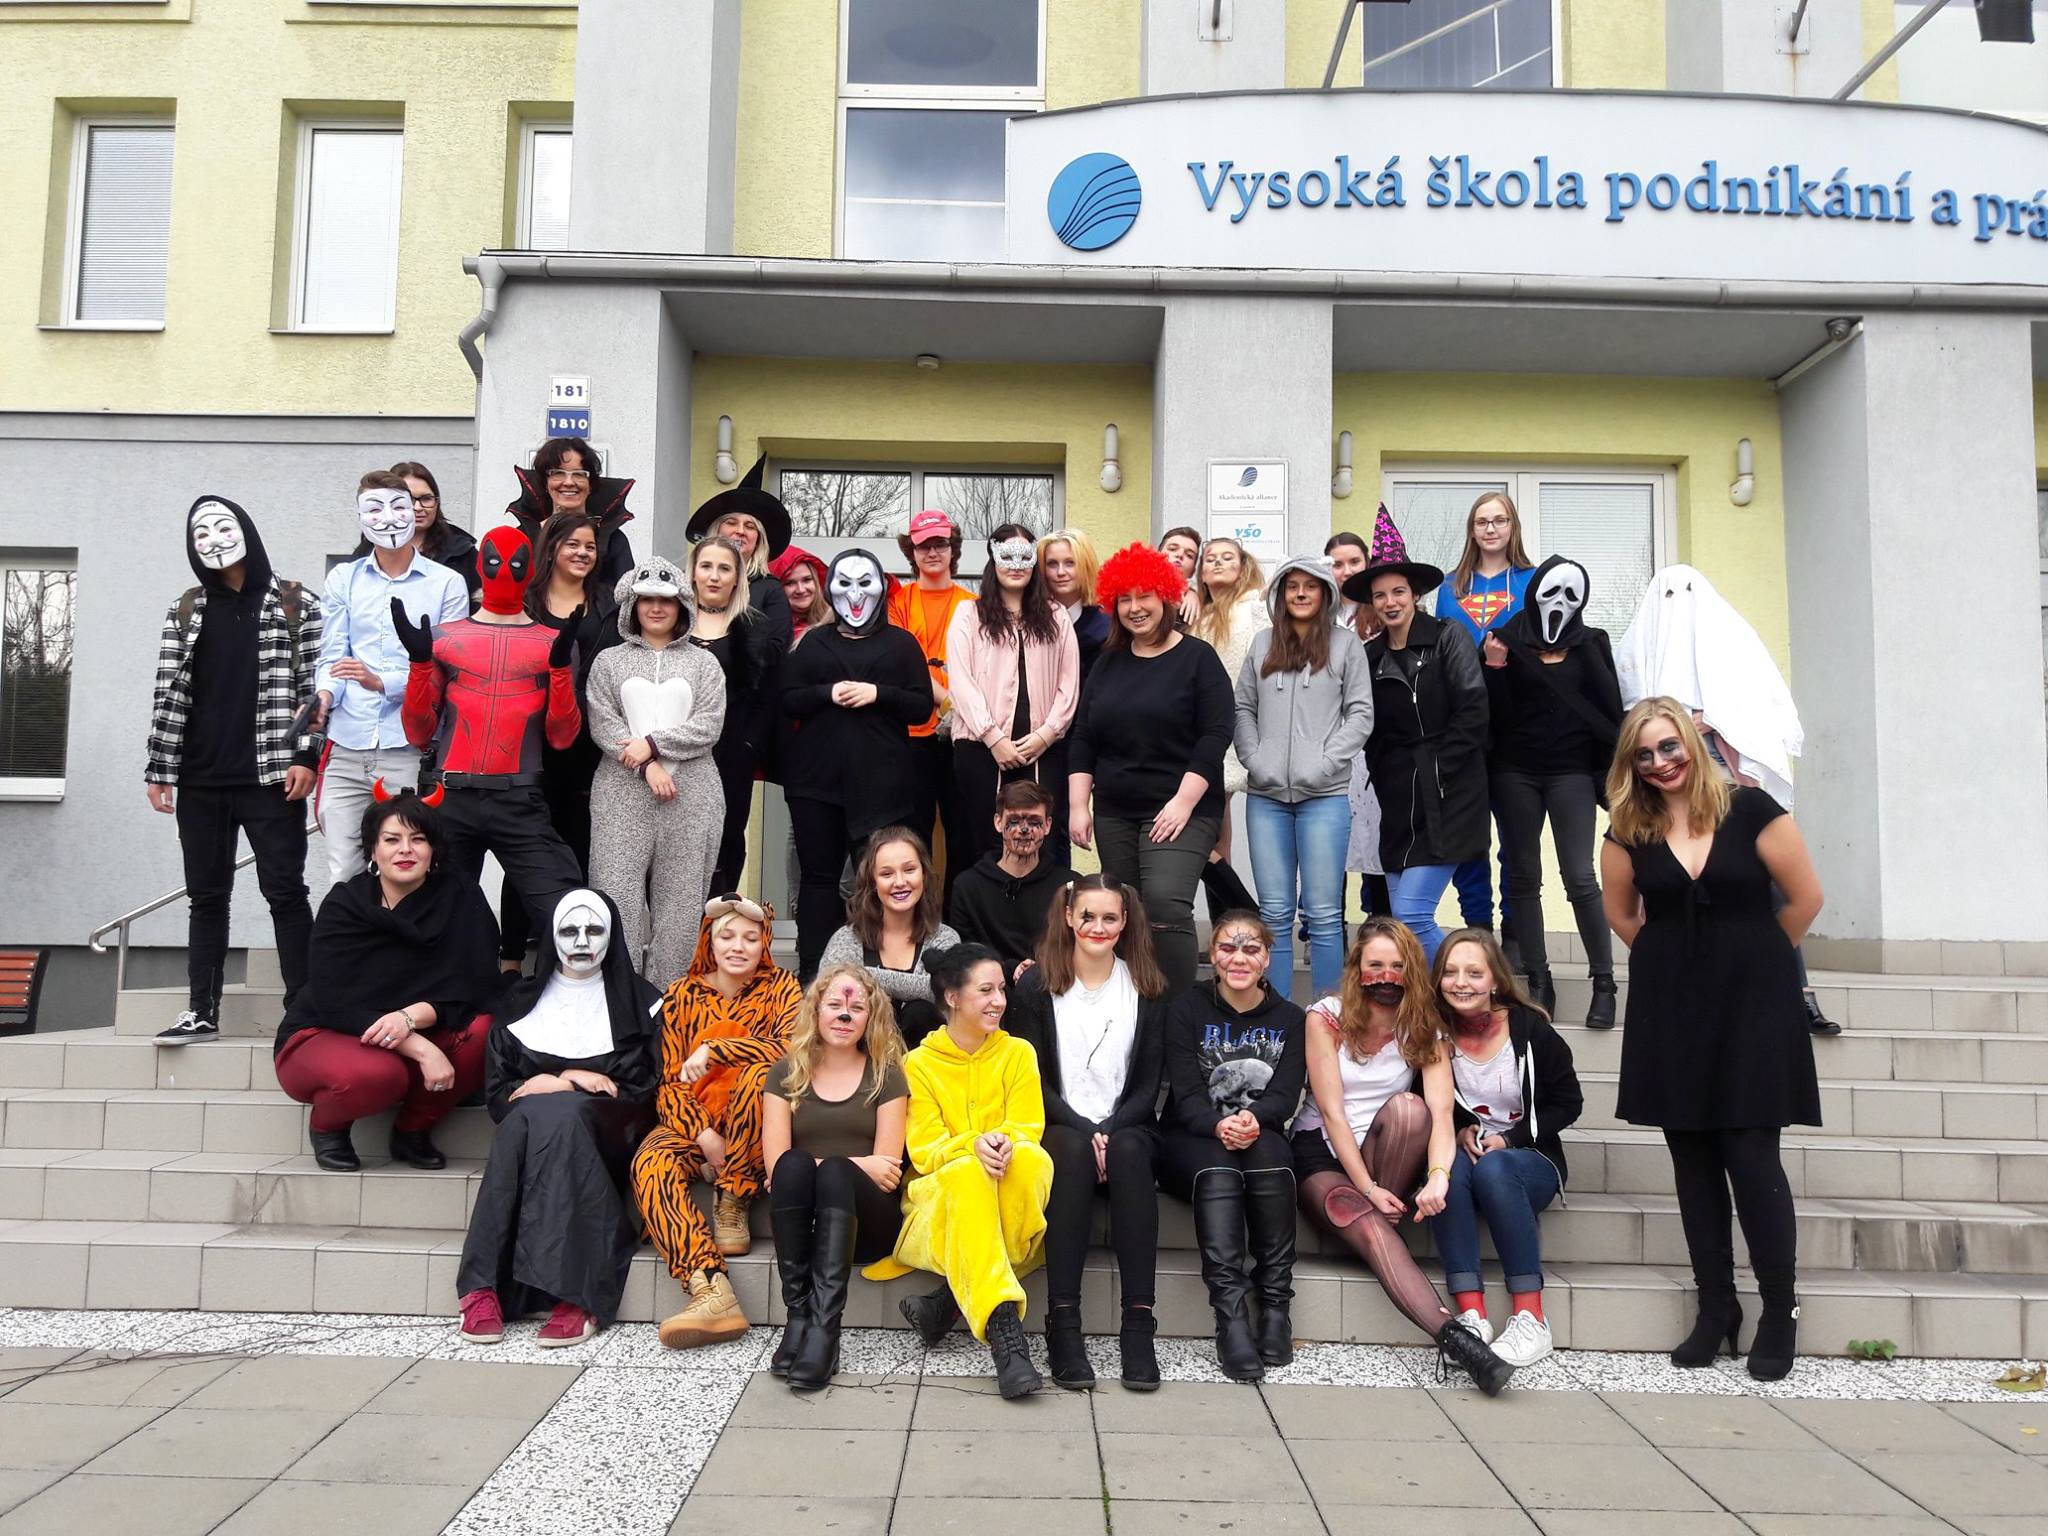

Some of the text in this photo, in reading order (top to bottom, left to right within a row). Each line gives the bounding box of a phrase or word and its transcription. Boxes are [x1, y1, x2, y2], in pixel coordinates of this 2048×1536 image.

[1187, 155, 2048, 242] Vysoká škola podnikání a prá
[555, 385, 583, 397] 181
[550, 417, 588, 430] 1810
